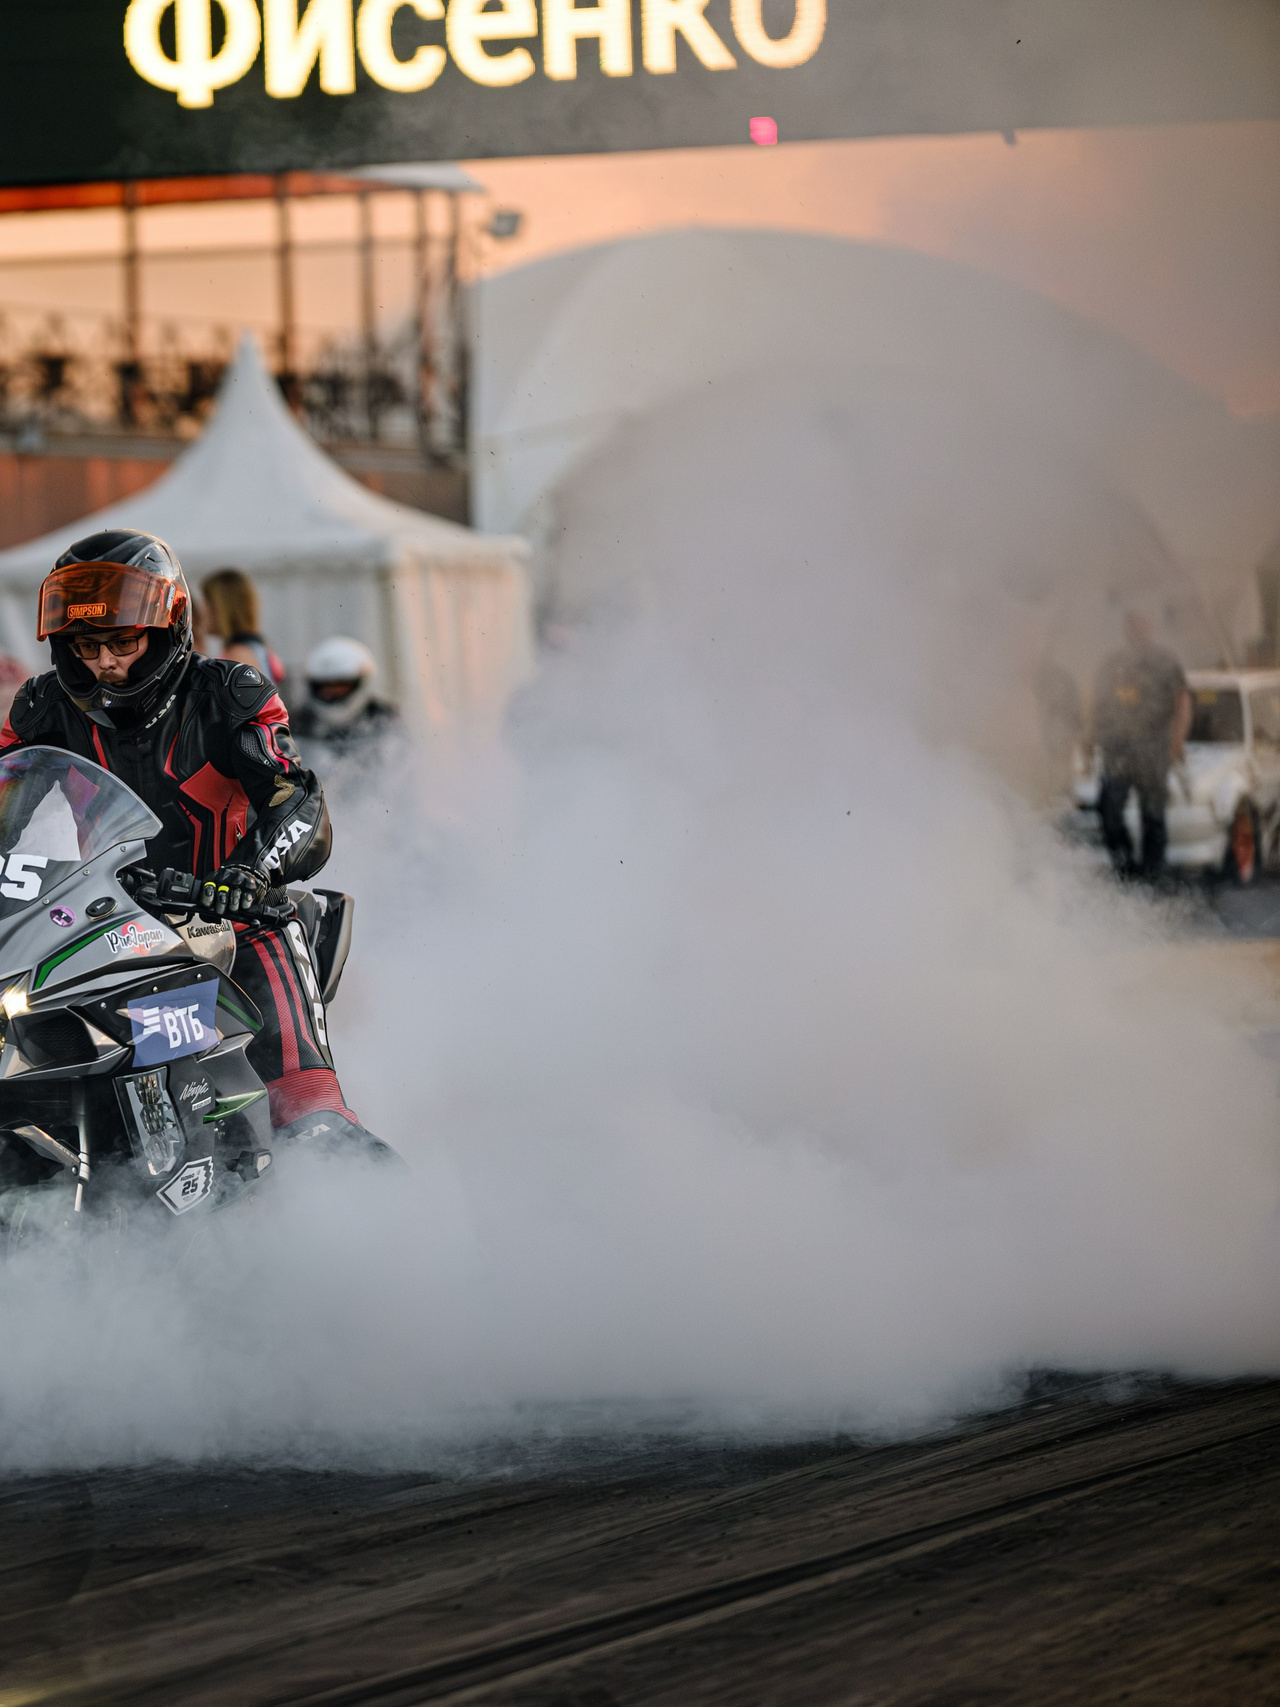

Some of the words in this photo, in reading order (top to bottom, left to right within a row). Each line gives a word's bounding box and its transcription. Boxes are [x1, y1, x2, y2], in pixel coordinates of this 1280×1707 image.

[123, 0, 826, 109] Фисенко
[69, 604, 104, 617] SIMPSON
[163, 1003, 204, 1049] ВТБ
[181, 1177, 199, 1197] 25
